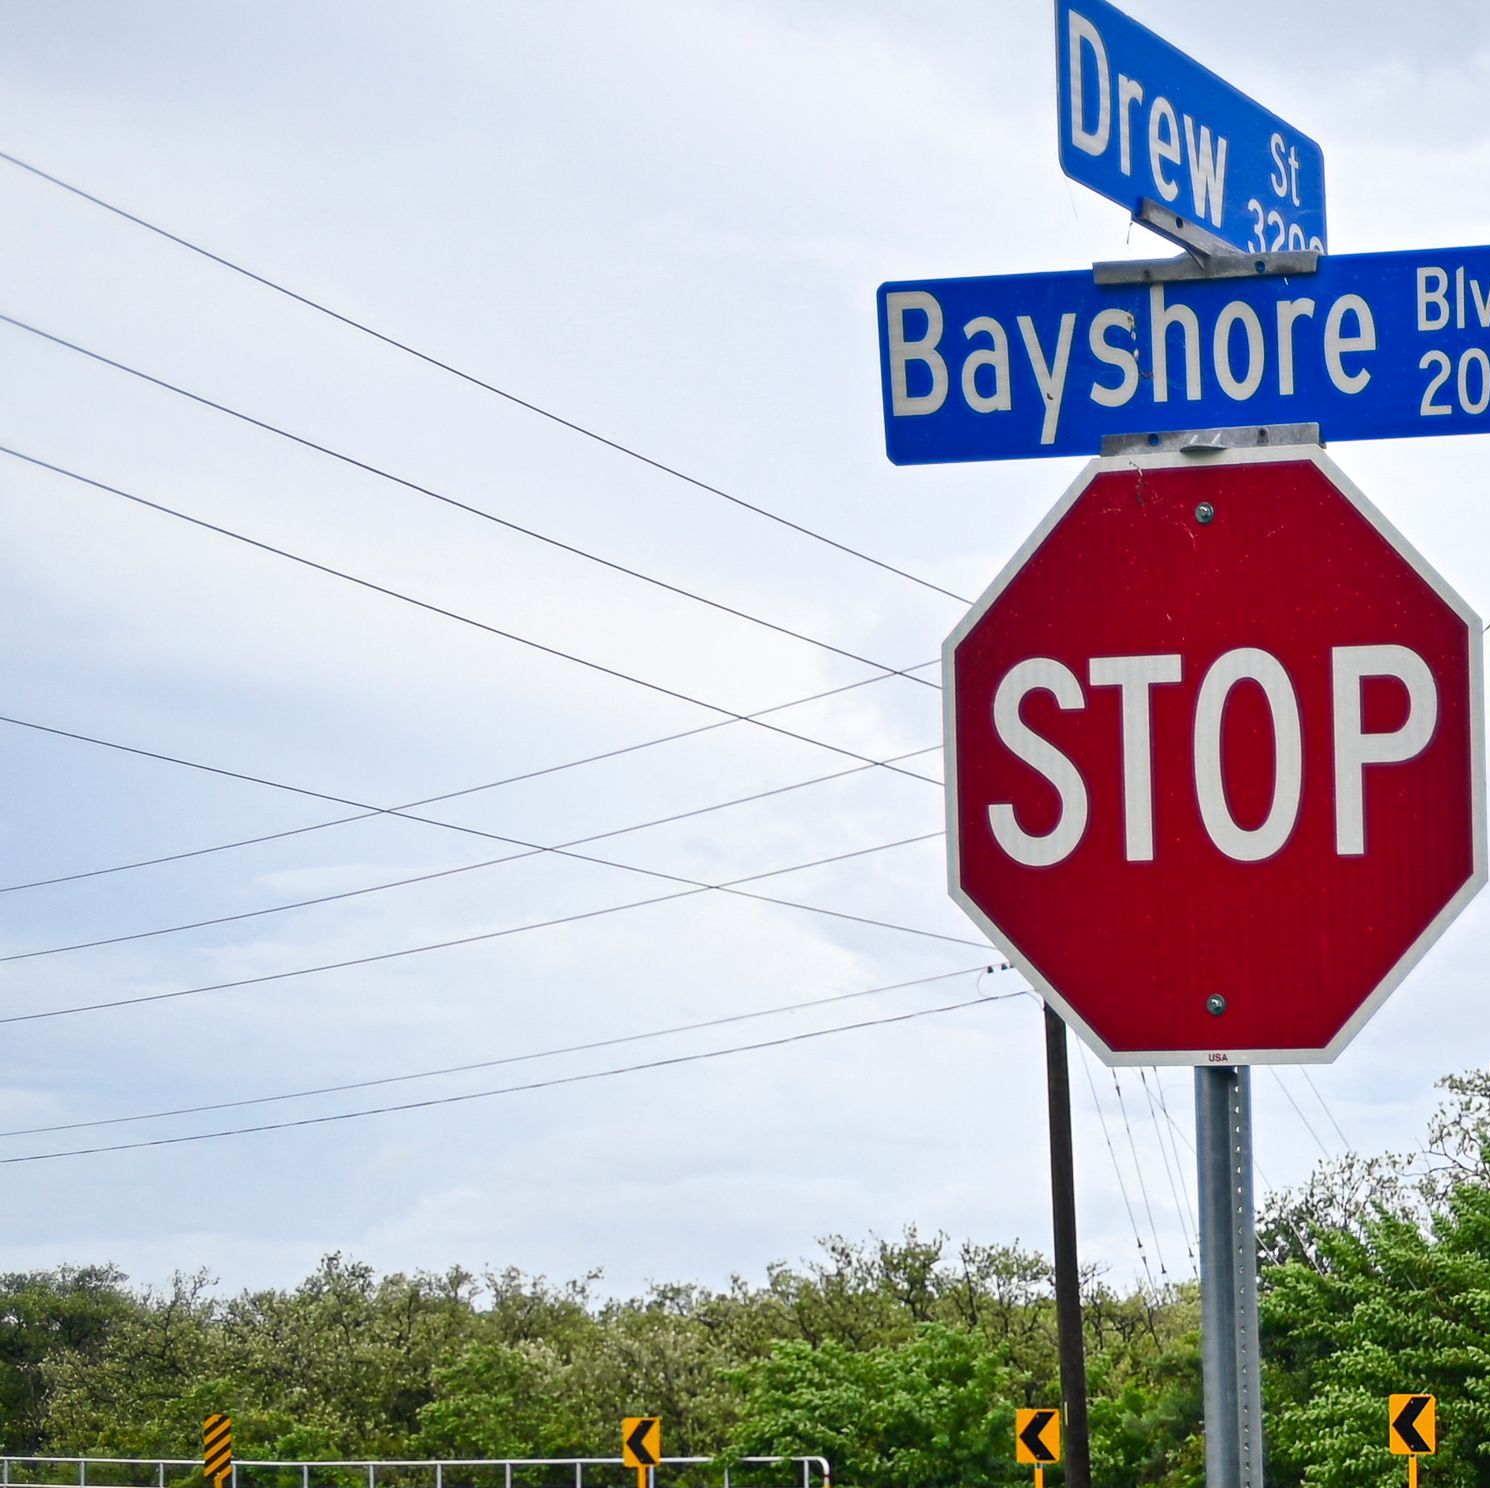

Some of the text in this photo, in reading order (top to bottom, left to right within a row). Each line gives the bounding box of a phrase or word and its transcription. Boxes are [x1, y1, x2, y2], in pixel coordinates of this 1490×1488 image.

[1068, 9, 1300, 228] Drew St
[1248, 199, 1325, 254] 32
[886, 283, 1377, 444] Bayshore
[988, 644, 1438, 867] STOP
[1209, 1053, 1228, 1062] USA
